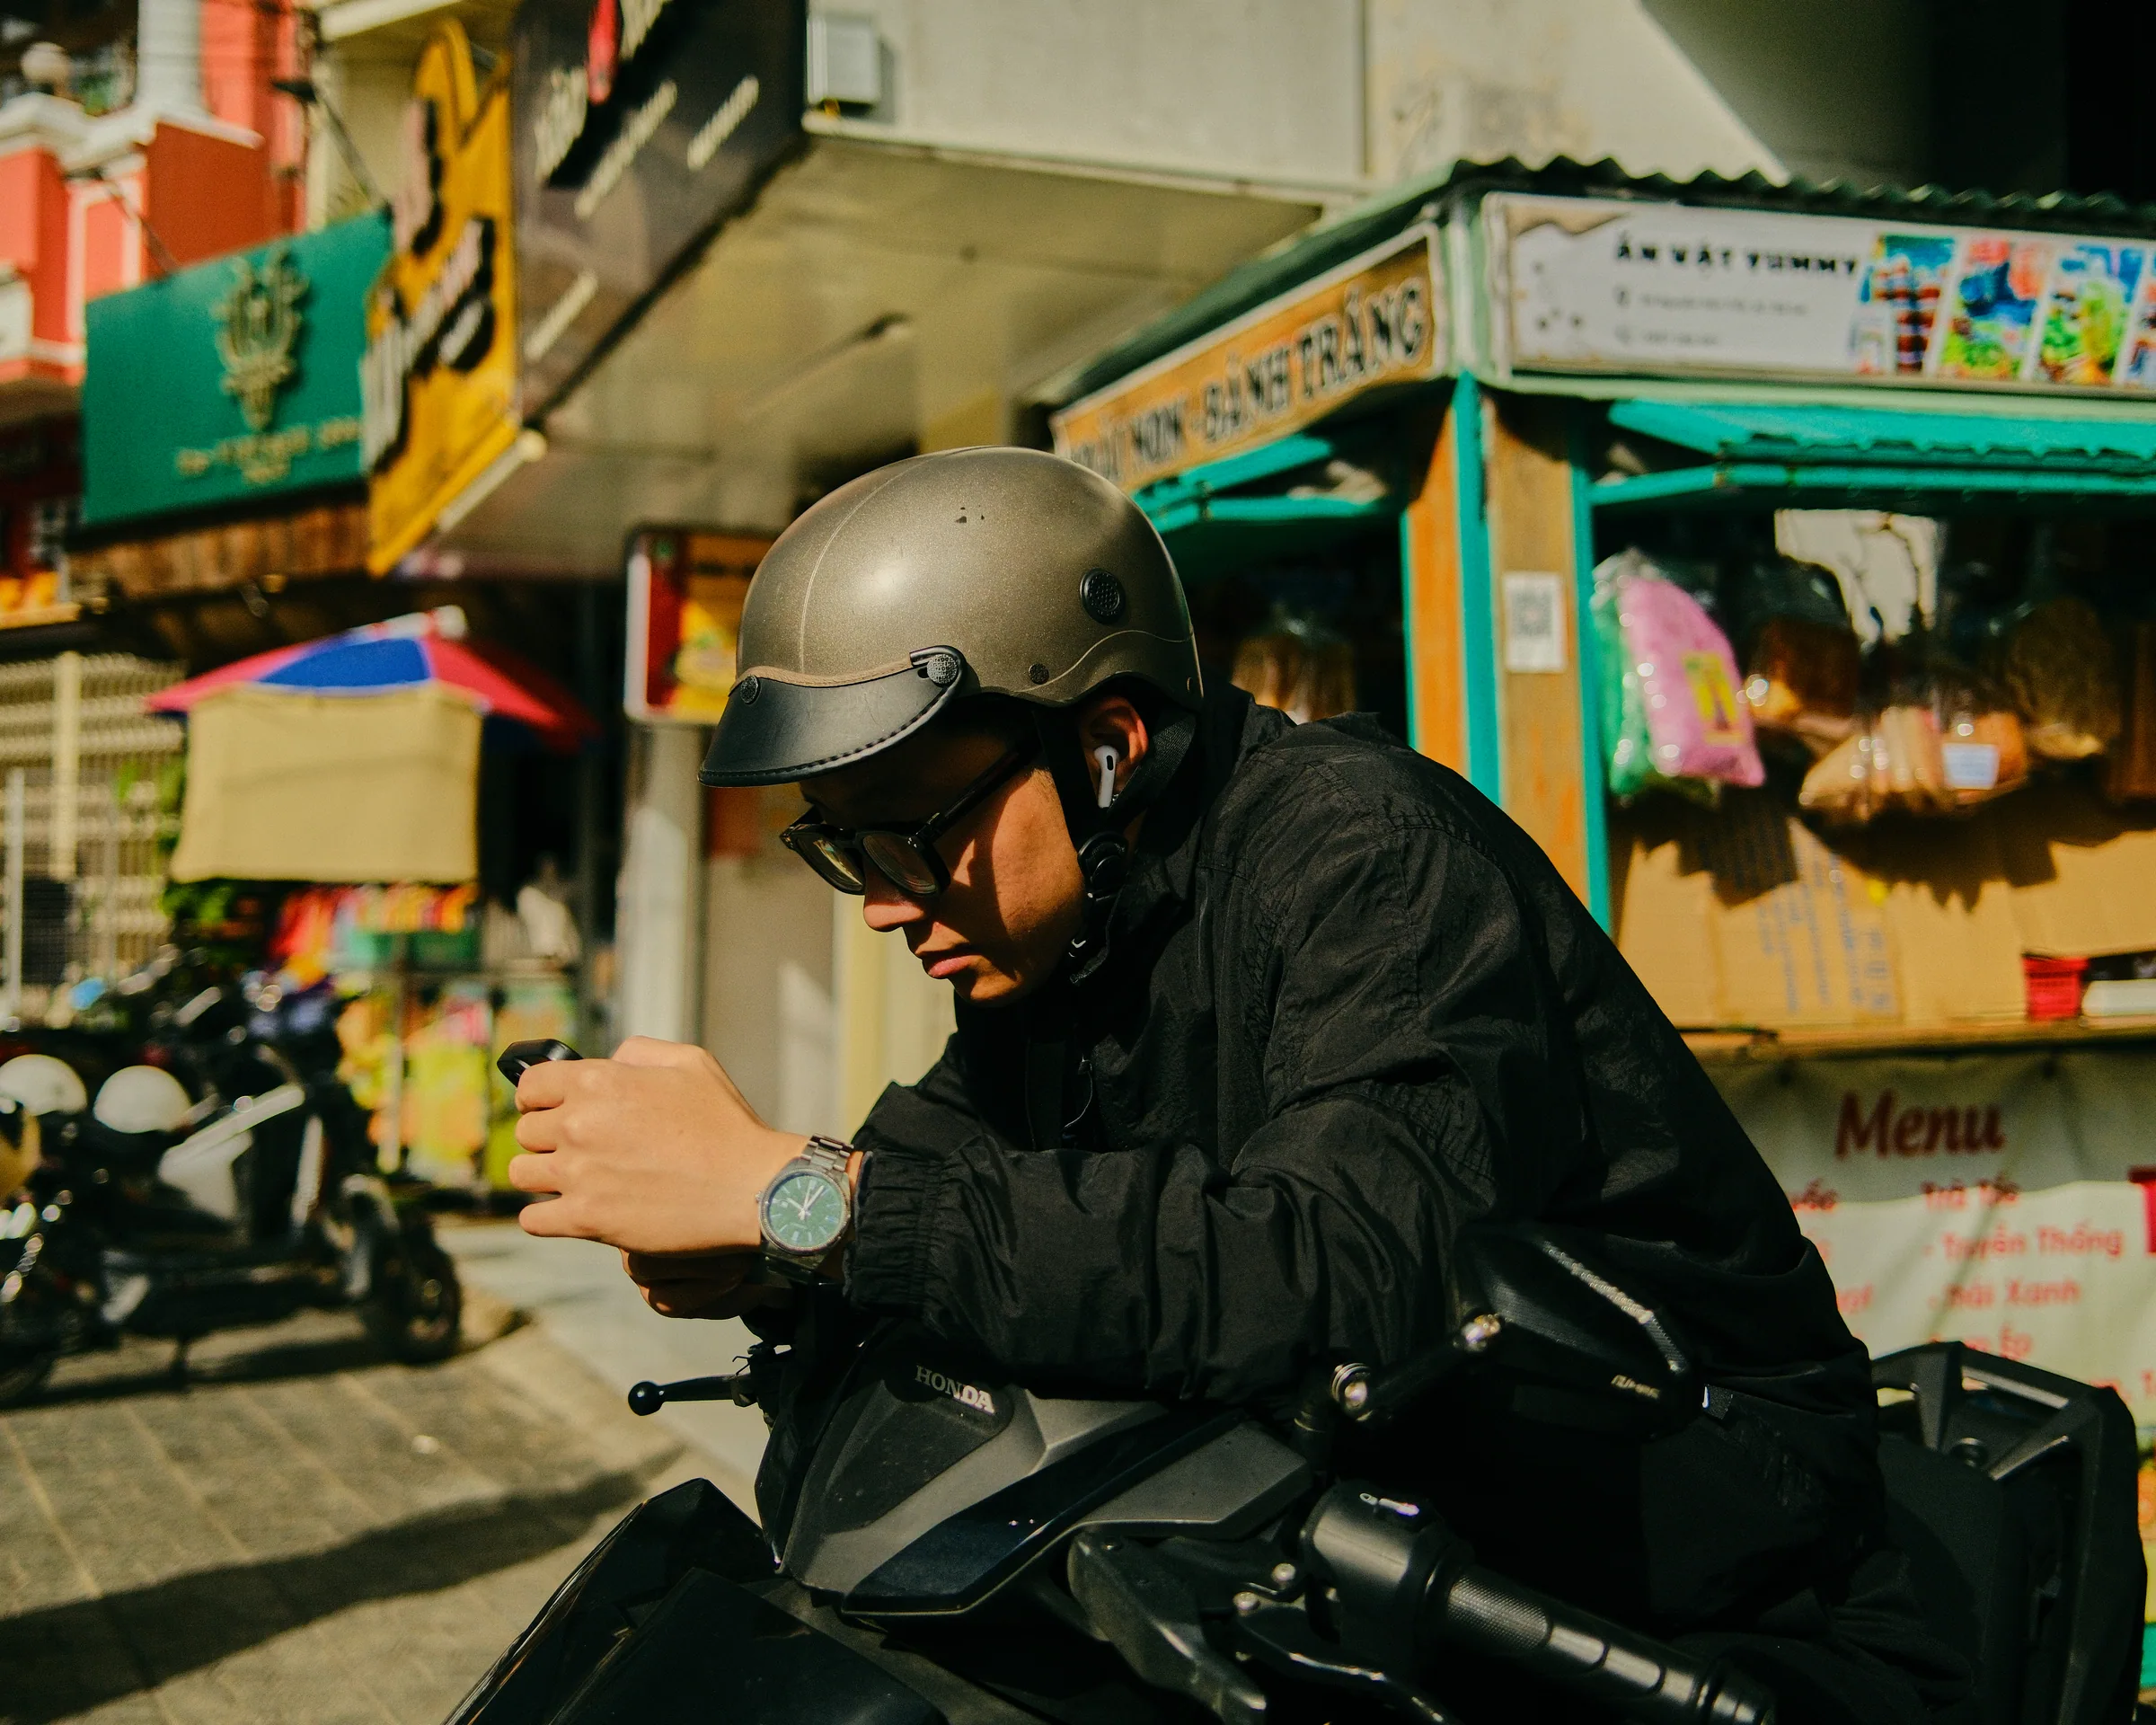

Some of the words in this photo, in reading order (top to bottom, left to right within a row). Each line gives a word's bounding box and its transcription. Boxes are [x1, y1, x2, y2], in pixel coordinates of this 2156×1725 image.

[1746, 248, 1859, 275] YUMMY
[1835, 1089, 2004, 1160] Menu
[2036, 1218, 2125, 1258] Thống
[2006, 1276, 2081, 1308] Xanh
[915, 1365, 995, 1415] HONDA
